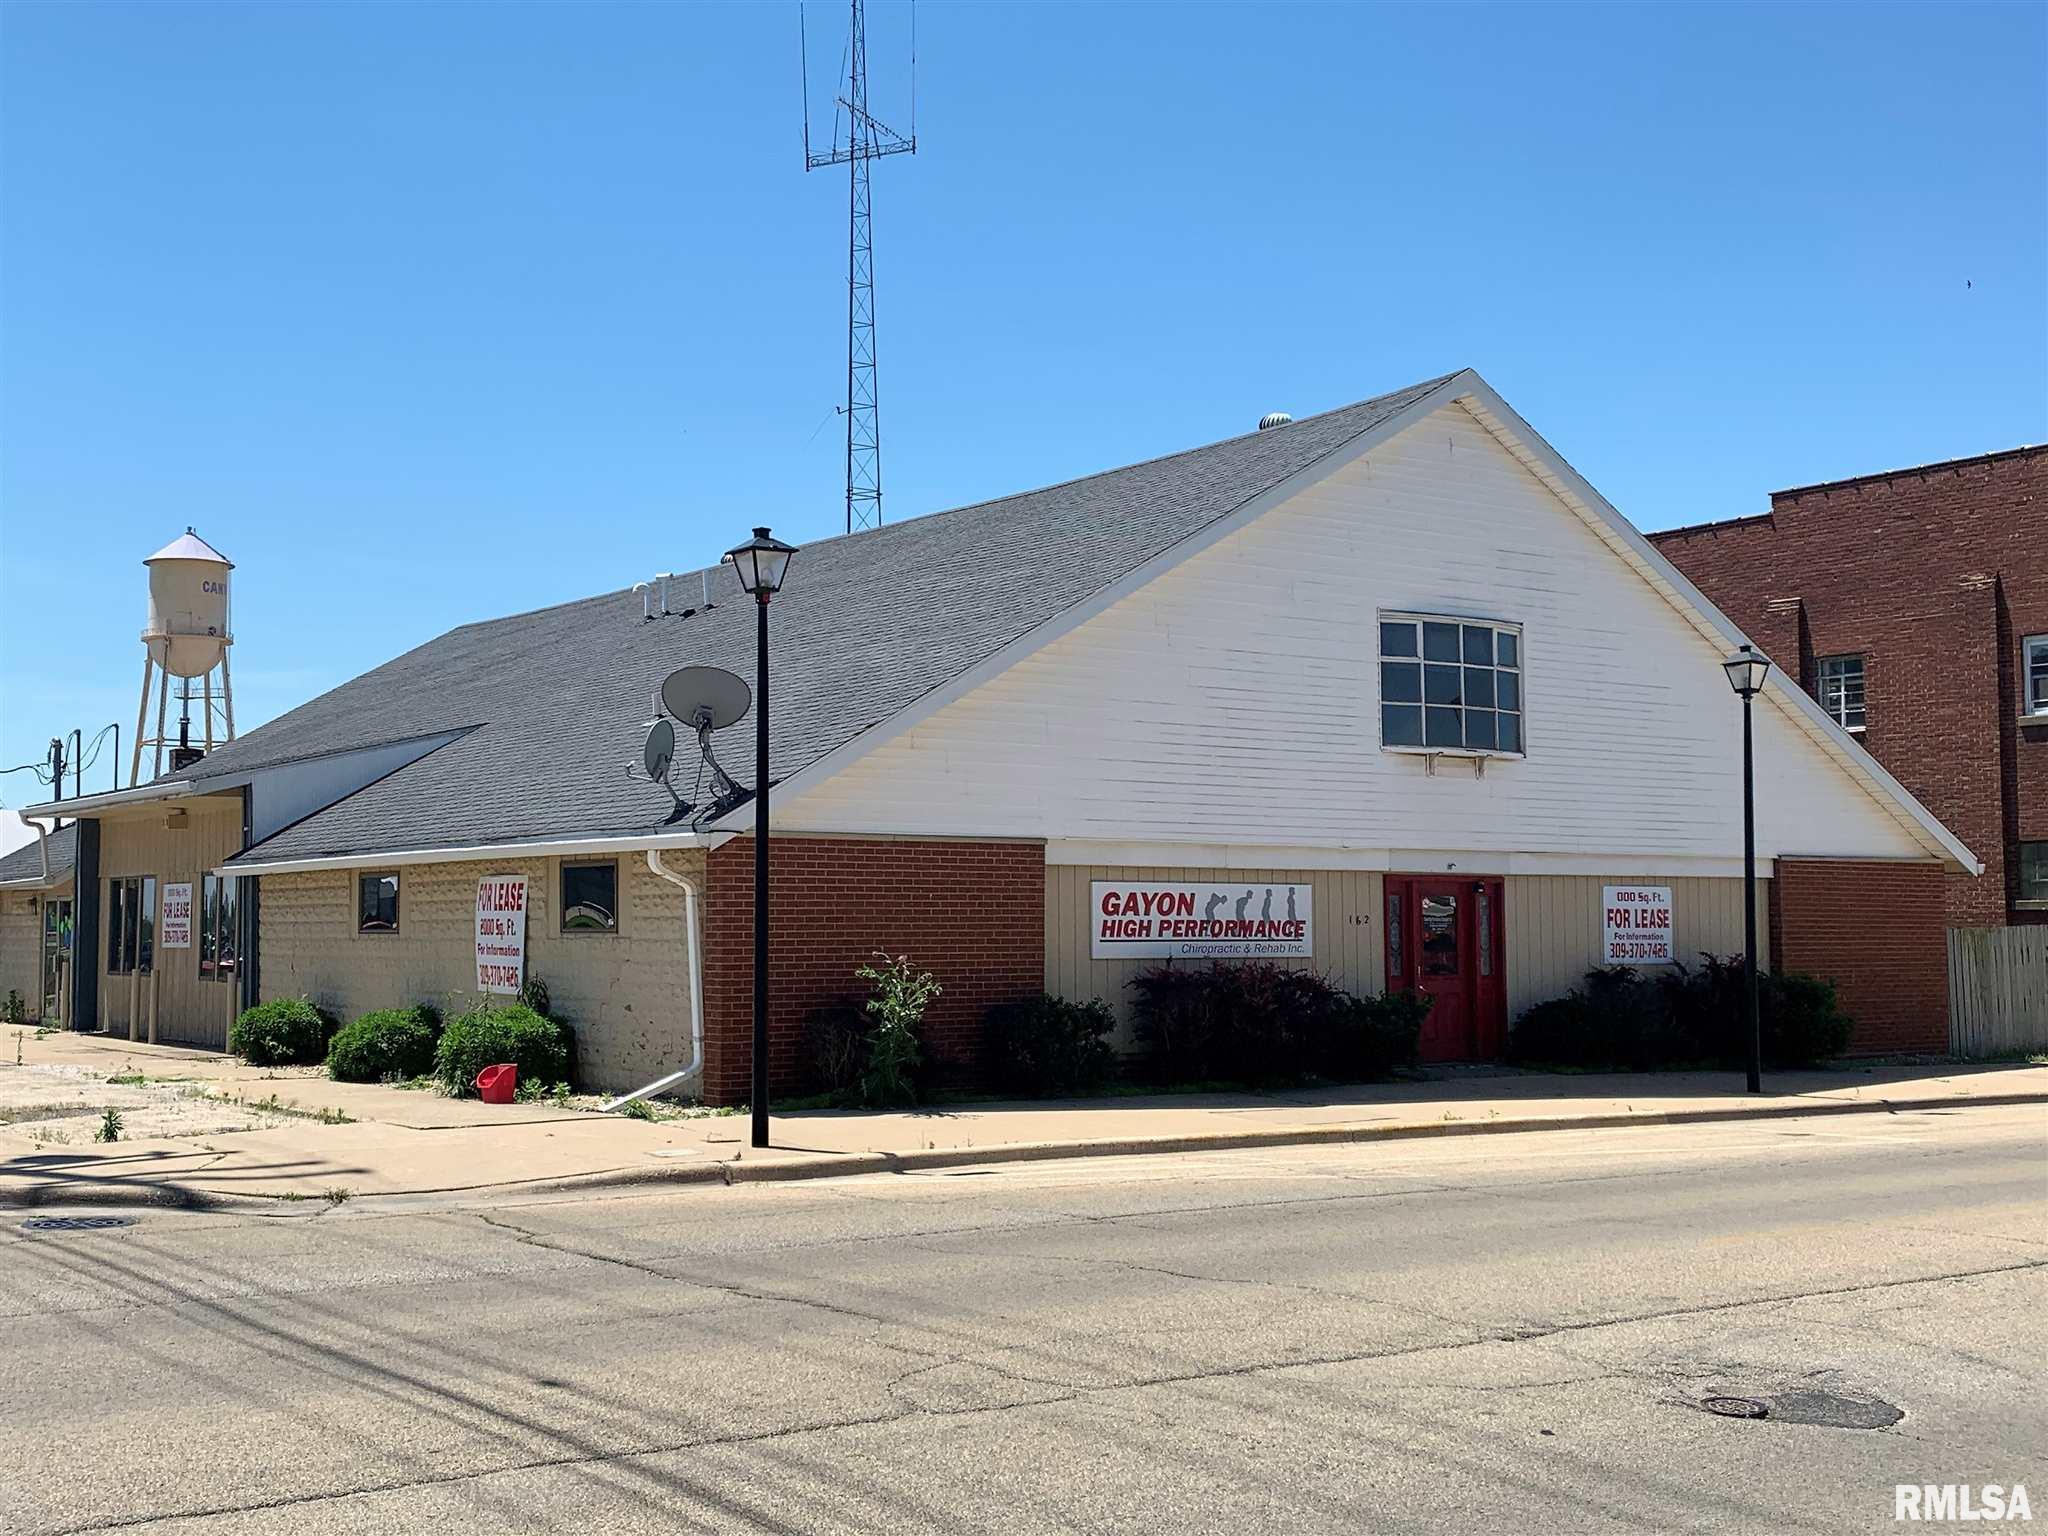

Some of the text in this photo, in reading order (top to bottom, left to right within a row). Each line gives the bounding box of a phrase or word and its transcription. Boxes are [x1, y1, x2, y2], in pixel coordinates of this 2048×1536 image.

[477, 883, 524, 911] FOR LEASE
[1101, 892, 1196, 917] GAYON
[1617, 891, 1665, 904] 000 Sq. Ft.
[173, 902, 190, 918] LEASE
[1607, 908, 1670, 928] FOR LEASE
[1101, 919, 1307, 938] HIGH PERFORMANCE
[1349, 915, 1370, 926] 162
[495, 918, 506, 940] Sq.
[506, 918, 516, 936] Ft.
[1614, 932, 1665, 941] For Information
[477, 943, 521, 957] For Information
[1181, 943, 1305, 955] Chiropractic & Rehab Inc.
